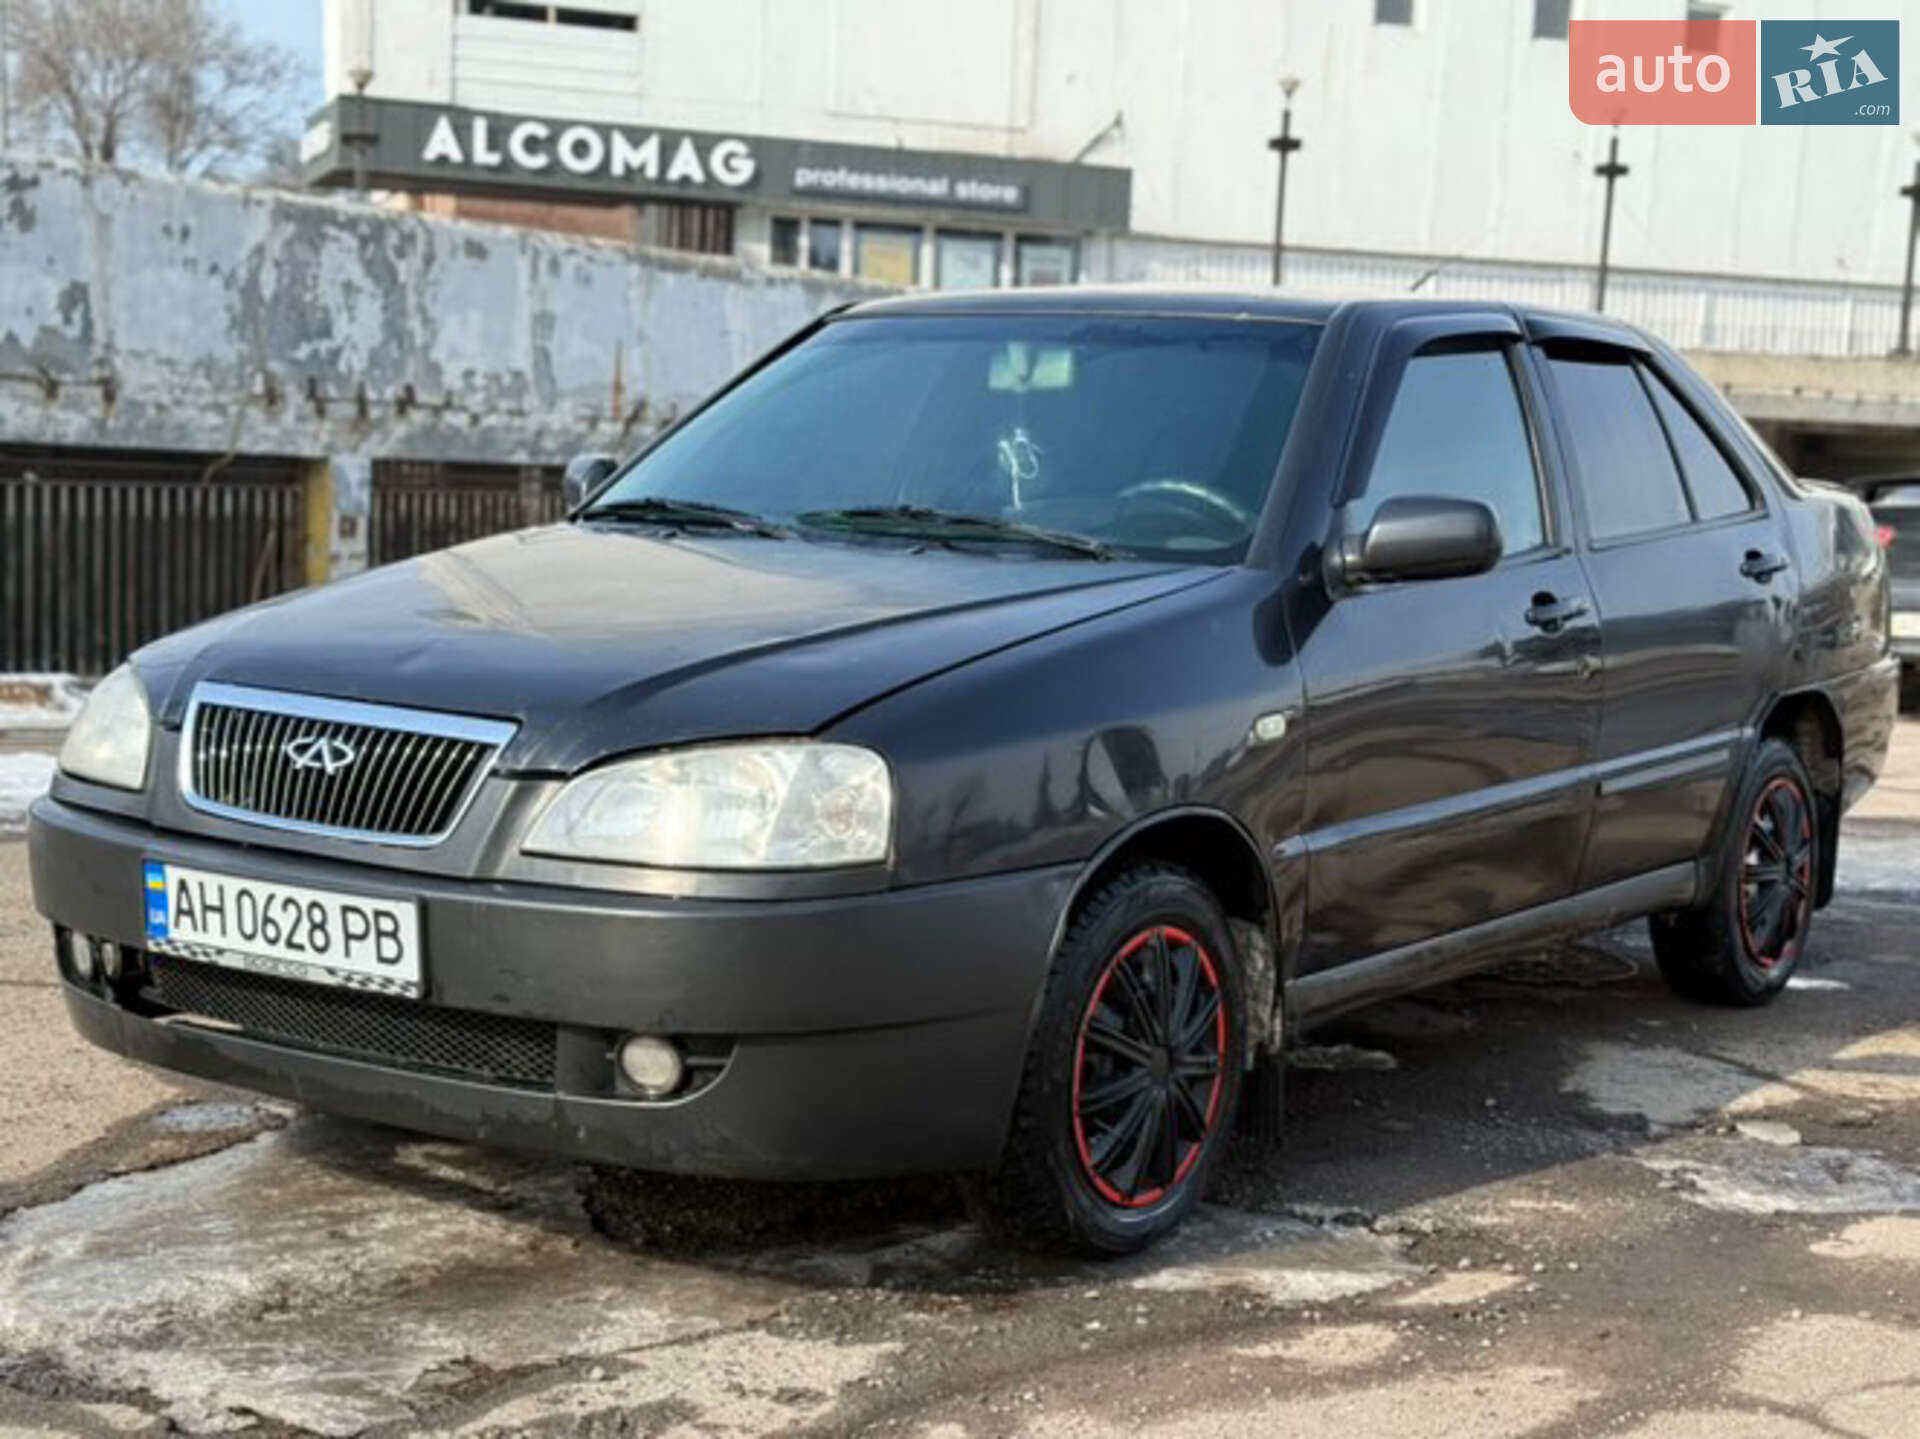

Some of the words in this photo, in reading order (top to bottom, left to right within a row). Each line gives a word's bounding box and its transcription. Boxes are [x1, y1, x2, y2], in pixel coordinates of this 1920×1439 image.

[421, 114, 757, 187] ALCOMAG
[794, 167, 949, 197] professional
[954, 179, 1020, 204] store
[173, 877, 227, 937] AH
[236, 887, 331, 955] 0628
[340, 904, 404, 966] PB
